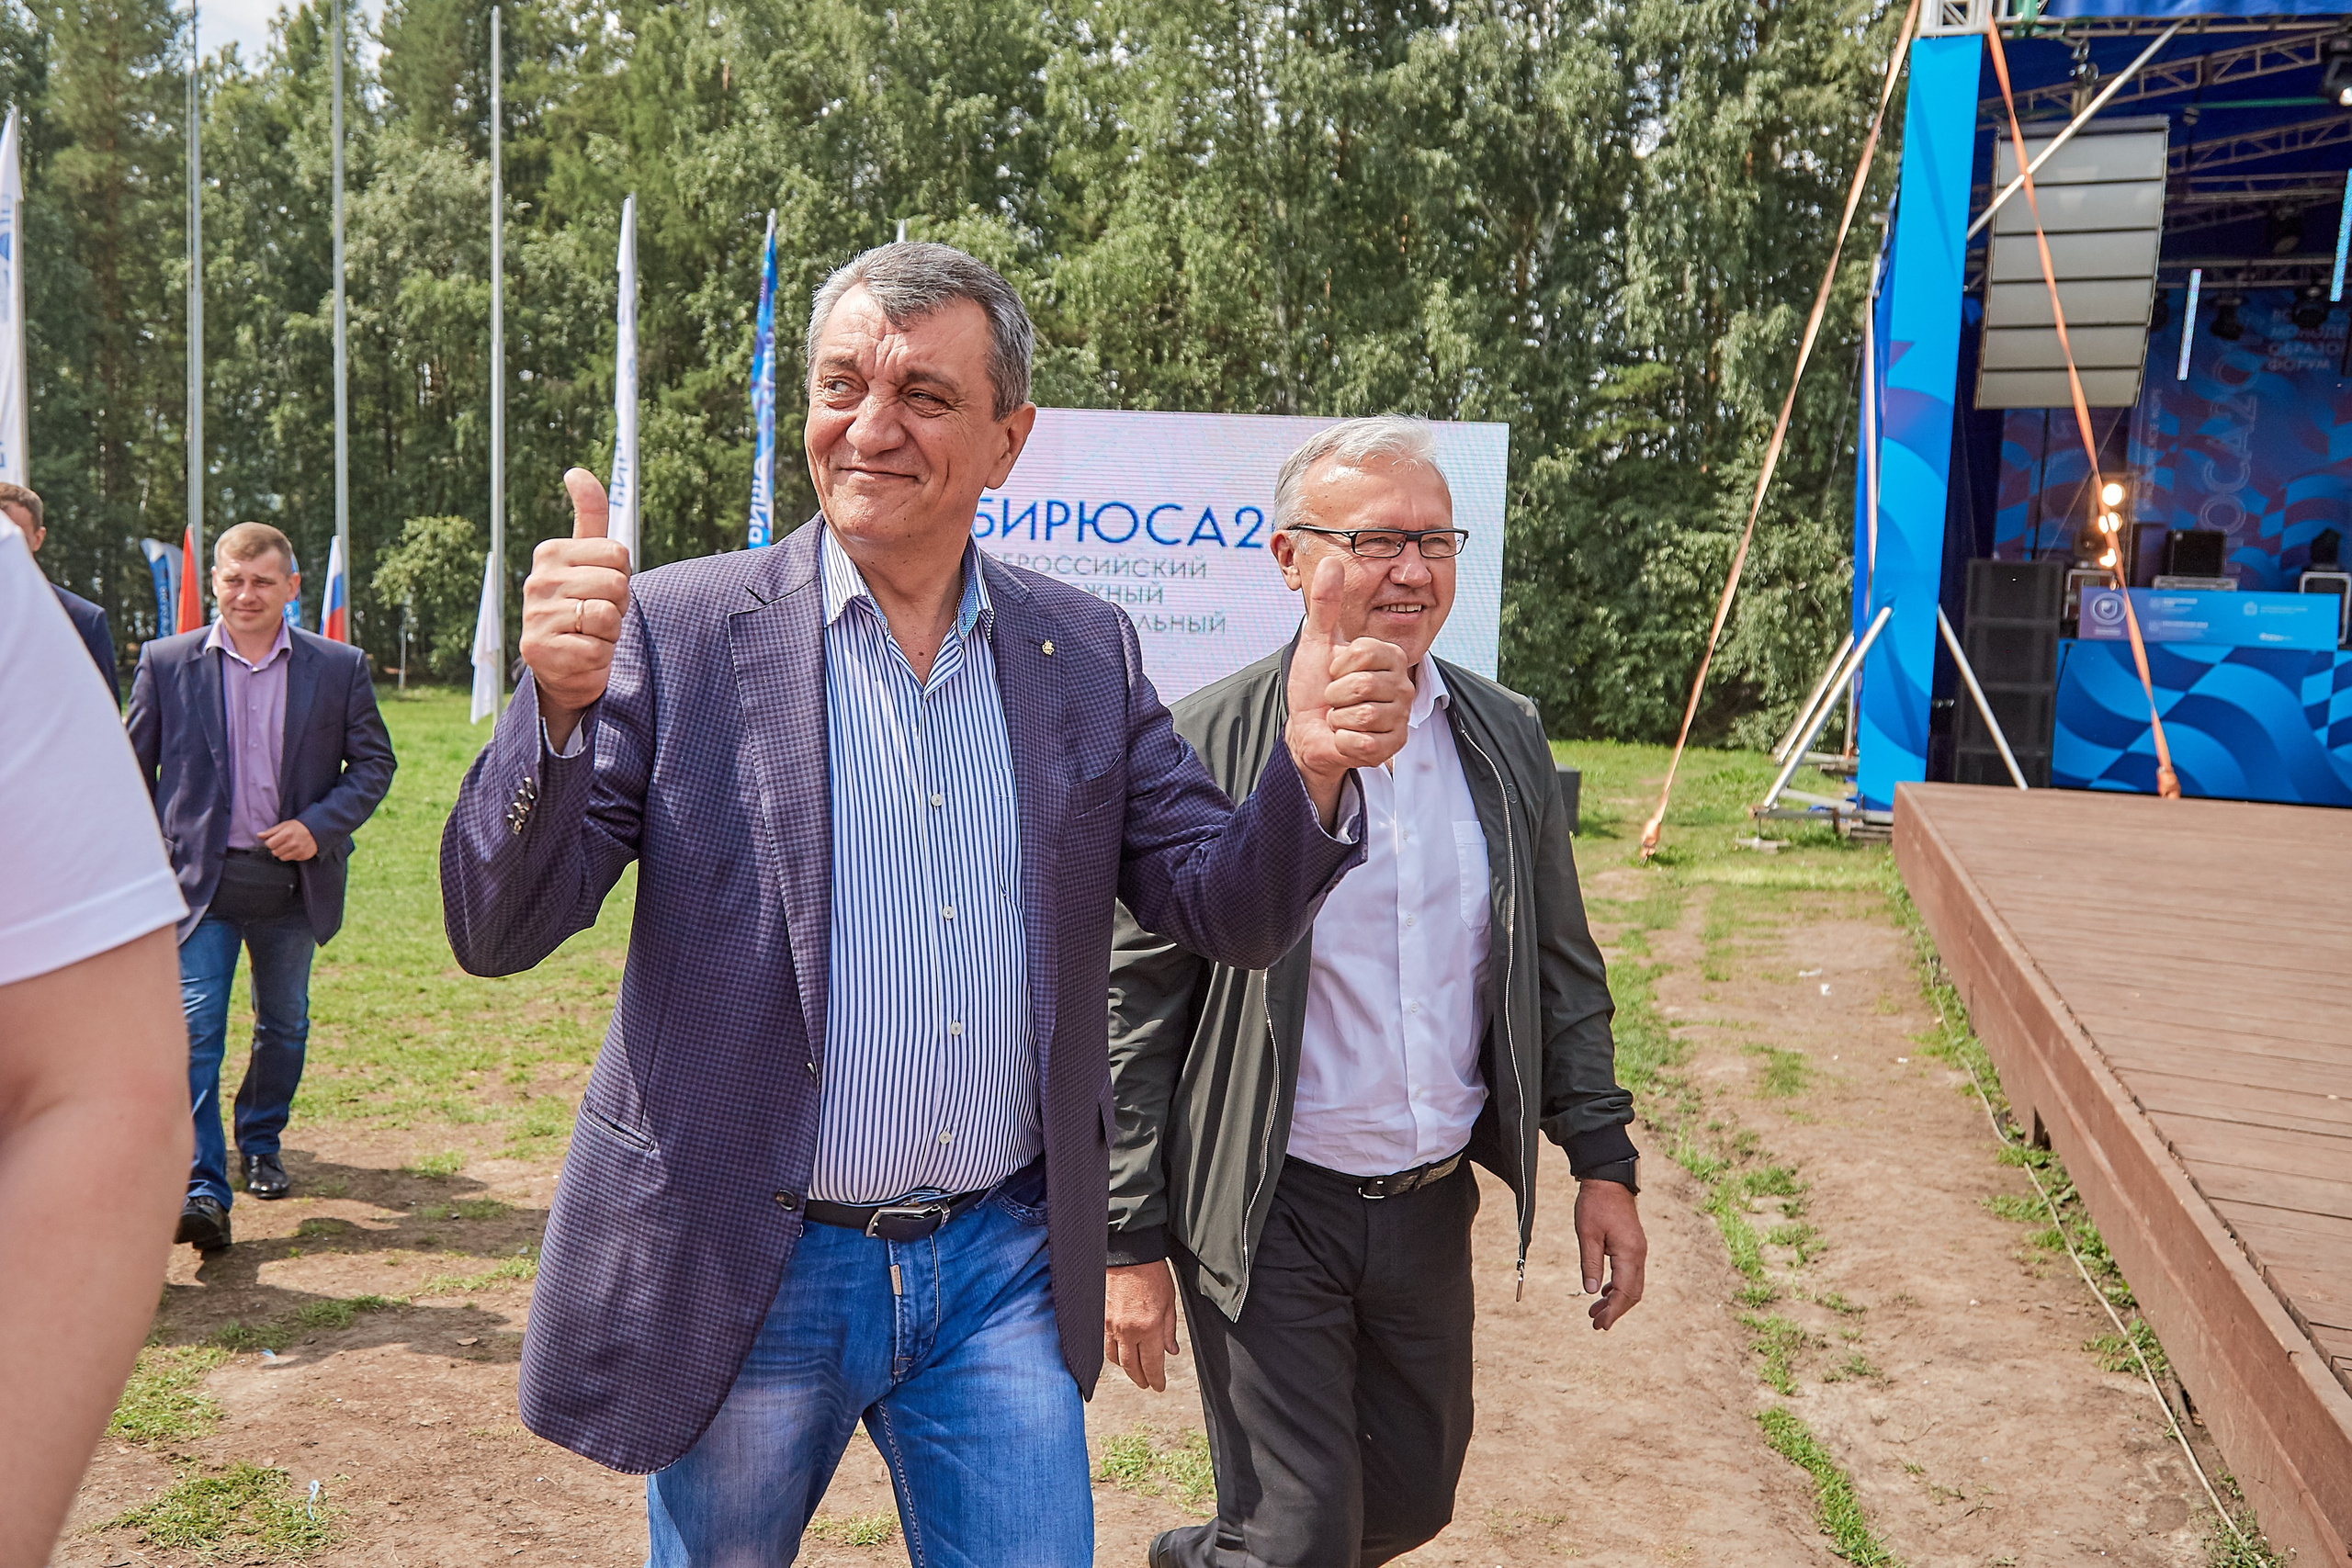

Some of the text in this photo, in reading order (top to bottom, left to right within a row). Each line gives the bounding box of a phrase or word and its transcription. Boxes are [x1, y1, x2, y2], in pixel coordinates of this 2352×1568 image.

[974, 498, 1265, 548] БИРЮСА2
[992, 552, 1207, 580] ЕРОССИЙСКИЙ
[1077, 581, 1163, 604] ЖНЫЙ
[1134, 610, 1226, 634] ЛЬНЫЙ
